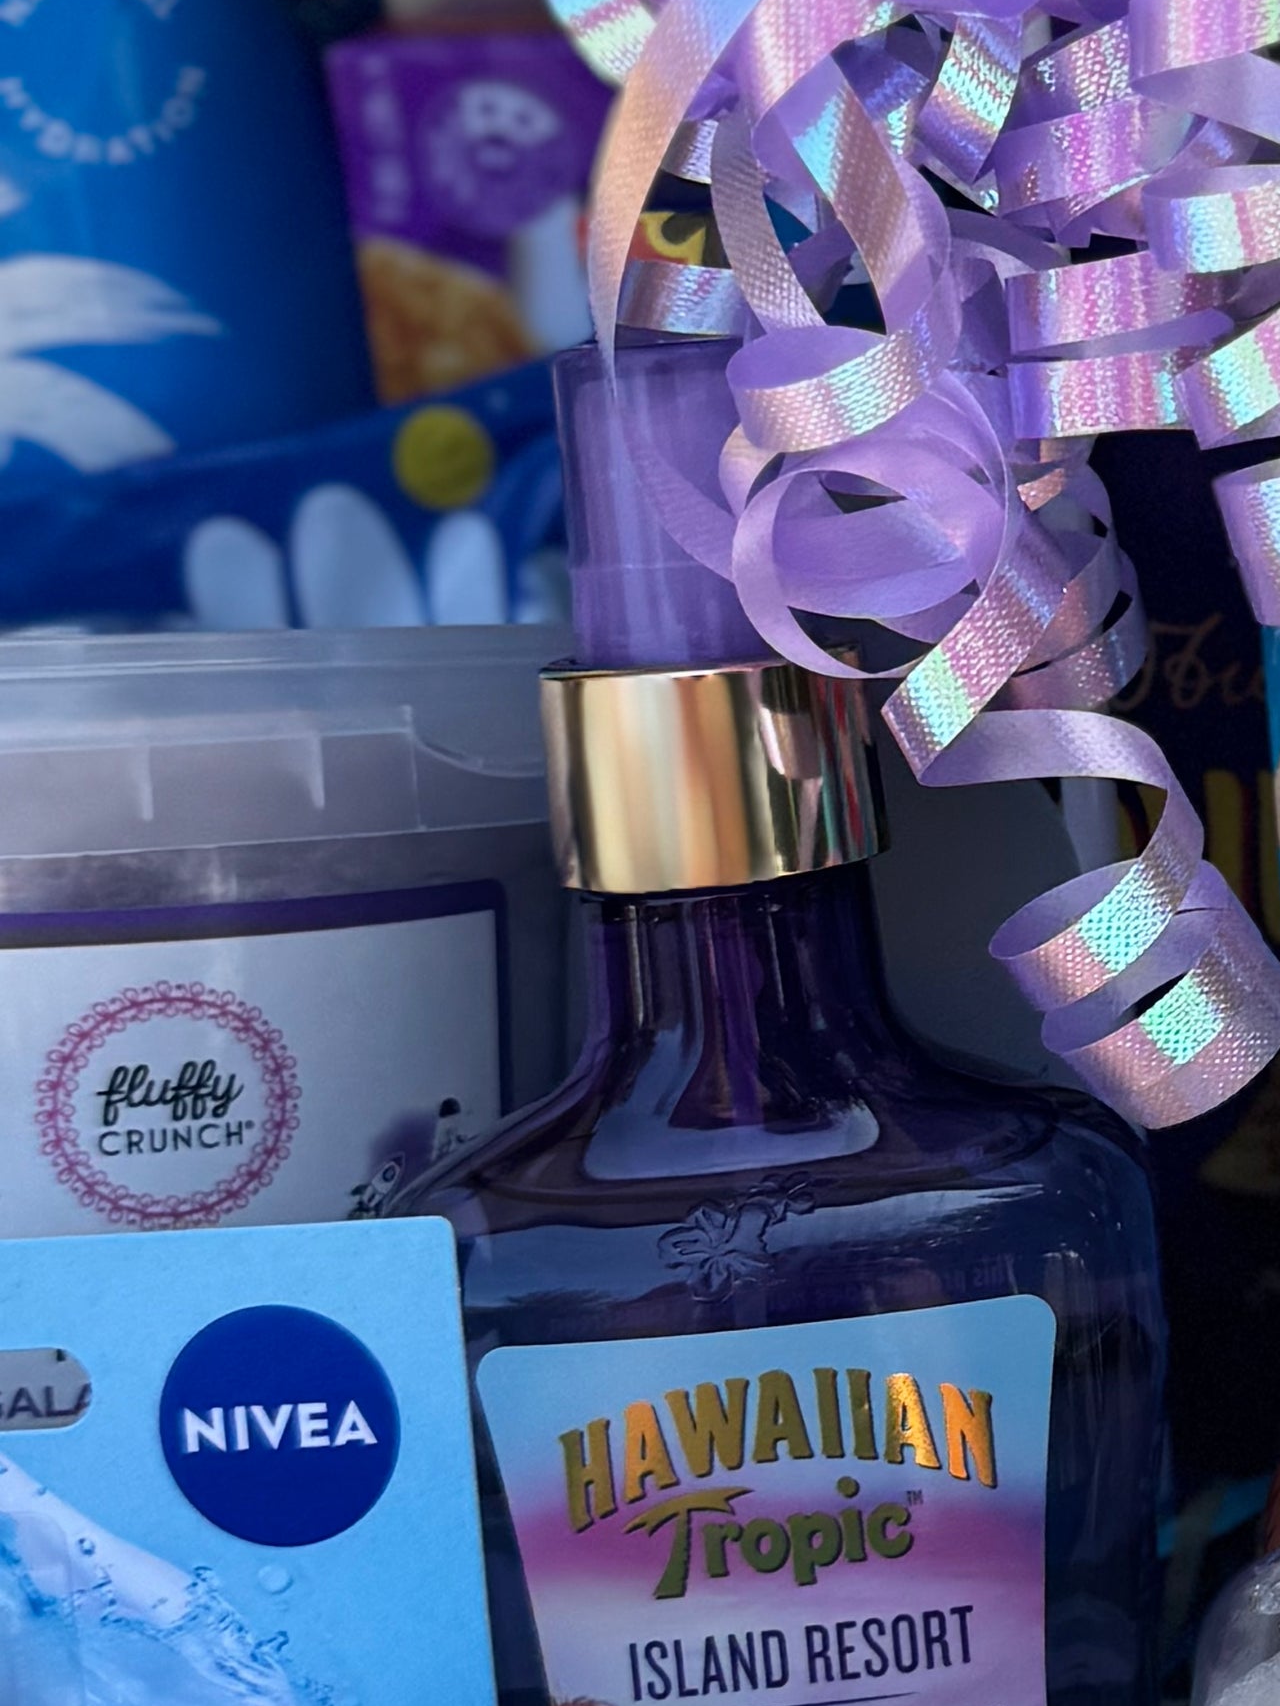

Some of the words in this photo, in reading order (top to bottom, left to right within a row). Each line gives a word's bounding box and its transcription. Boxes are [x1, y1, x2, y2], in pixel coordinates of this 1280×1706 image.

[96, 1059, 245, 1126] fluffy
[181, 1399, 379, 1455] NIVEA
[557, 1366, 999, 1535] HAWAIIAN
[628, 1626, 790, 1703] ISLAND
[805, 1604, 975, 1685] RESORT
